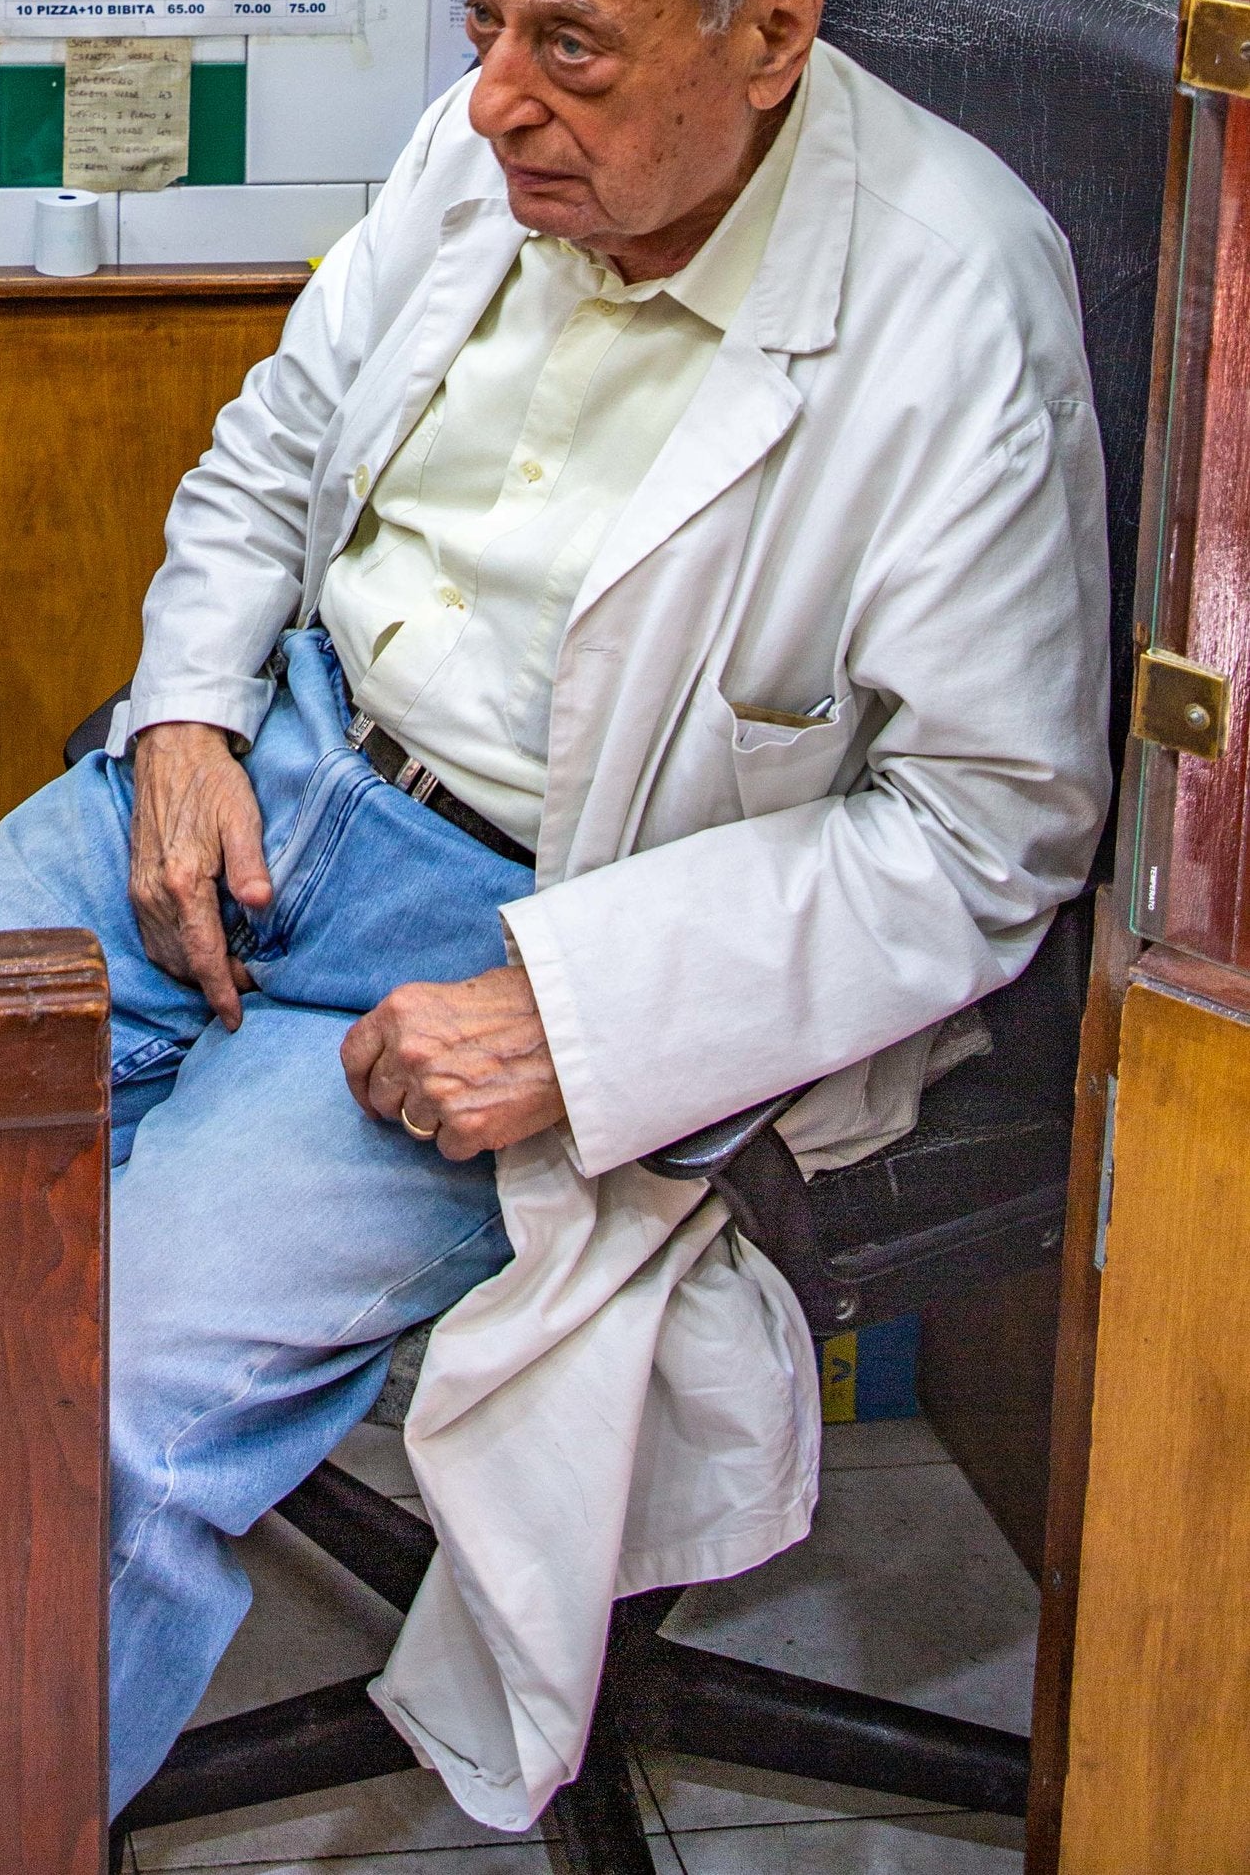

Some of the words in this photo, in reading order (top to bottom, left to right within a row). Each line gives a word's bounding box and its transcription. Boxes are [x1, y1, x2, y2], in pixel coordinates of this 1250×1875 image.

[16, 5, 33, 16] 10
[37, 5, 105, 16] PIZZA+10
[108, 4, 155, 15] BIBITA
[167, 4, 205, 15] 65.00
[234, 3, 271, 14] 70.00
[289, 2, 326, 14] 75.00
